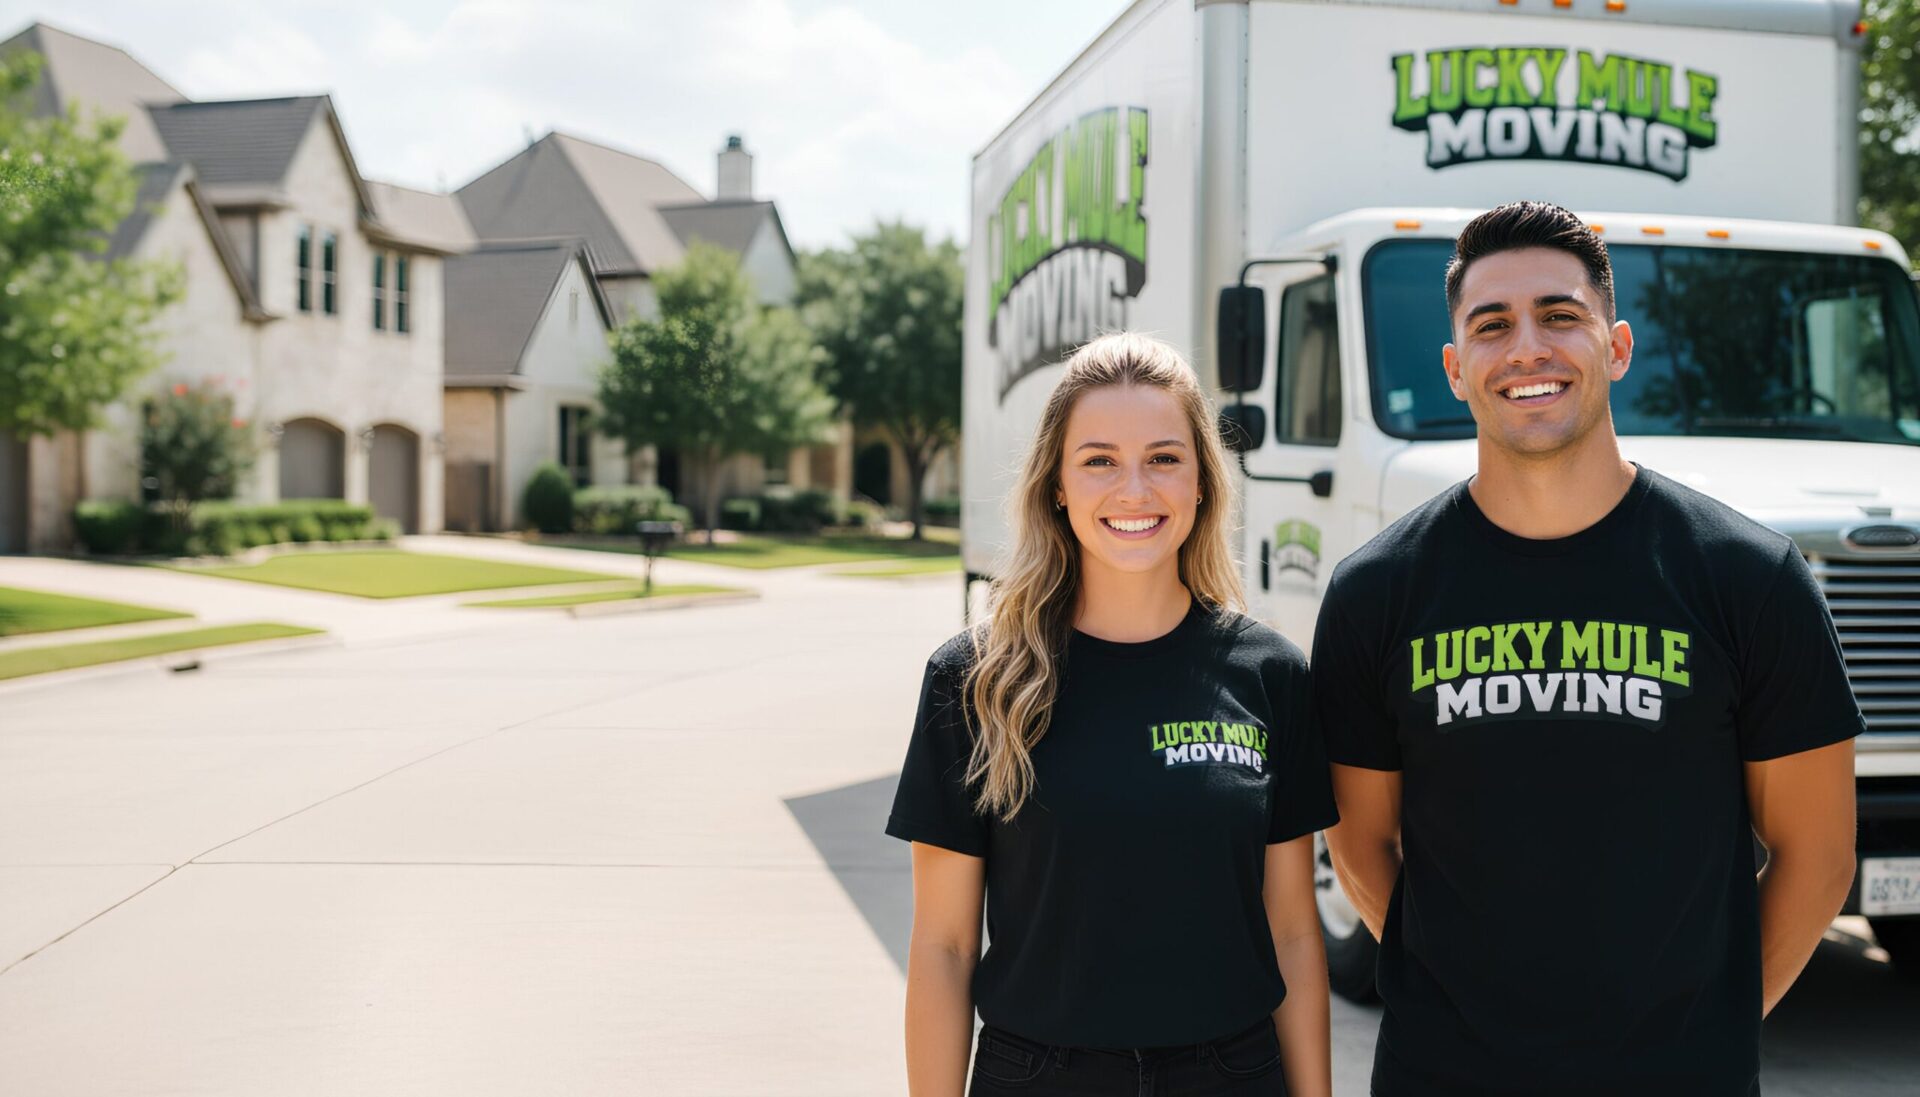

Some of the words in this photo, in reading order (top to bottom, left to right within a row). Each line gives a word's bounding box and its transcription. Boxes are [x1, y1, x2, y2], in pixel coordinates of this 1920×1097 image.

[1394, 48, 1567, 121] LUCKY
[1577, 51, 1717, 141] MULE
[1427, 107, 1687, 177] MOVING
[996, 248, 1127, 396] MOVING
[1411, 621, 1553, 692] LUCKY
[1560, 620, 1690, 688] MULE
[1436, 672, 1662, 726] MOVING
[1151, 720, 1218, 751] LUCKY
[1165, 742, 1263, 773] MOVING
